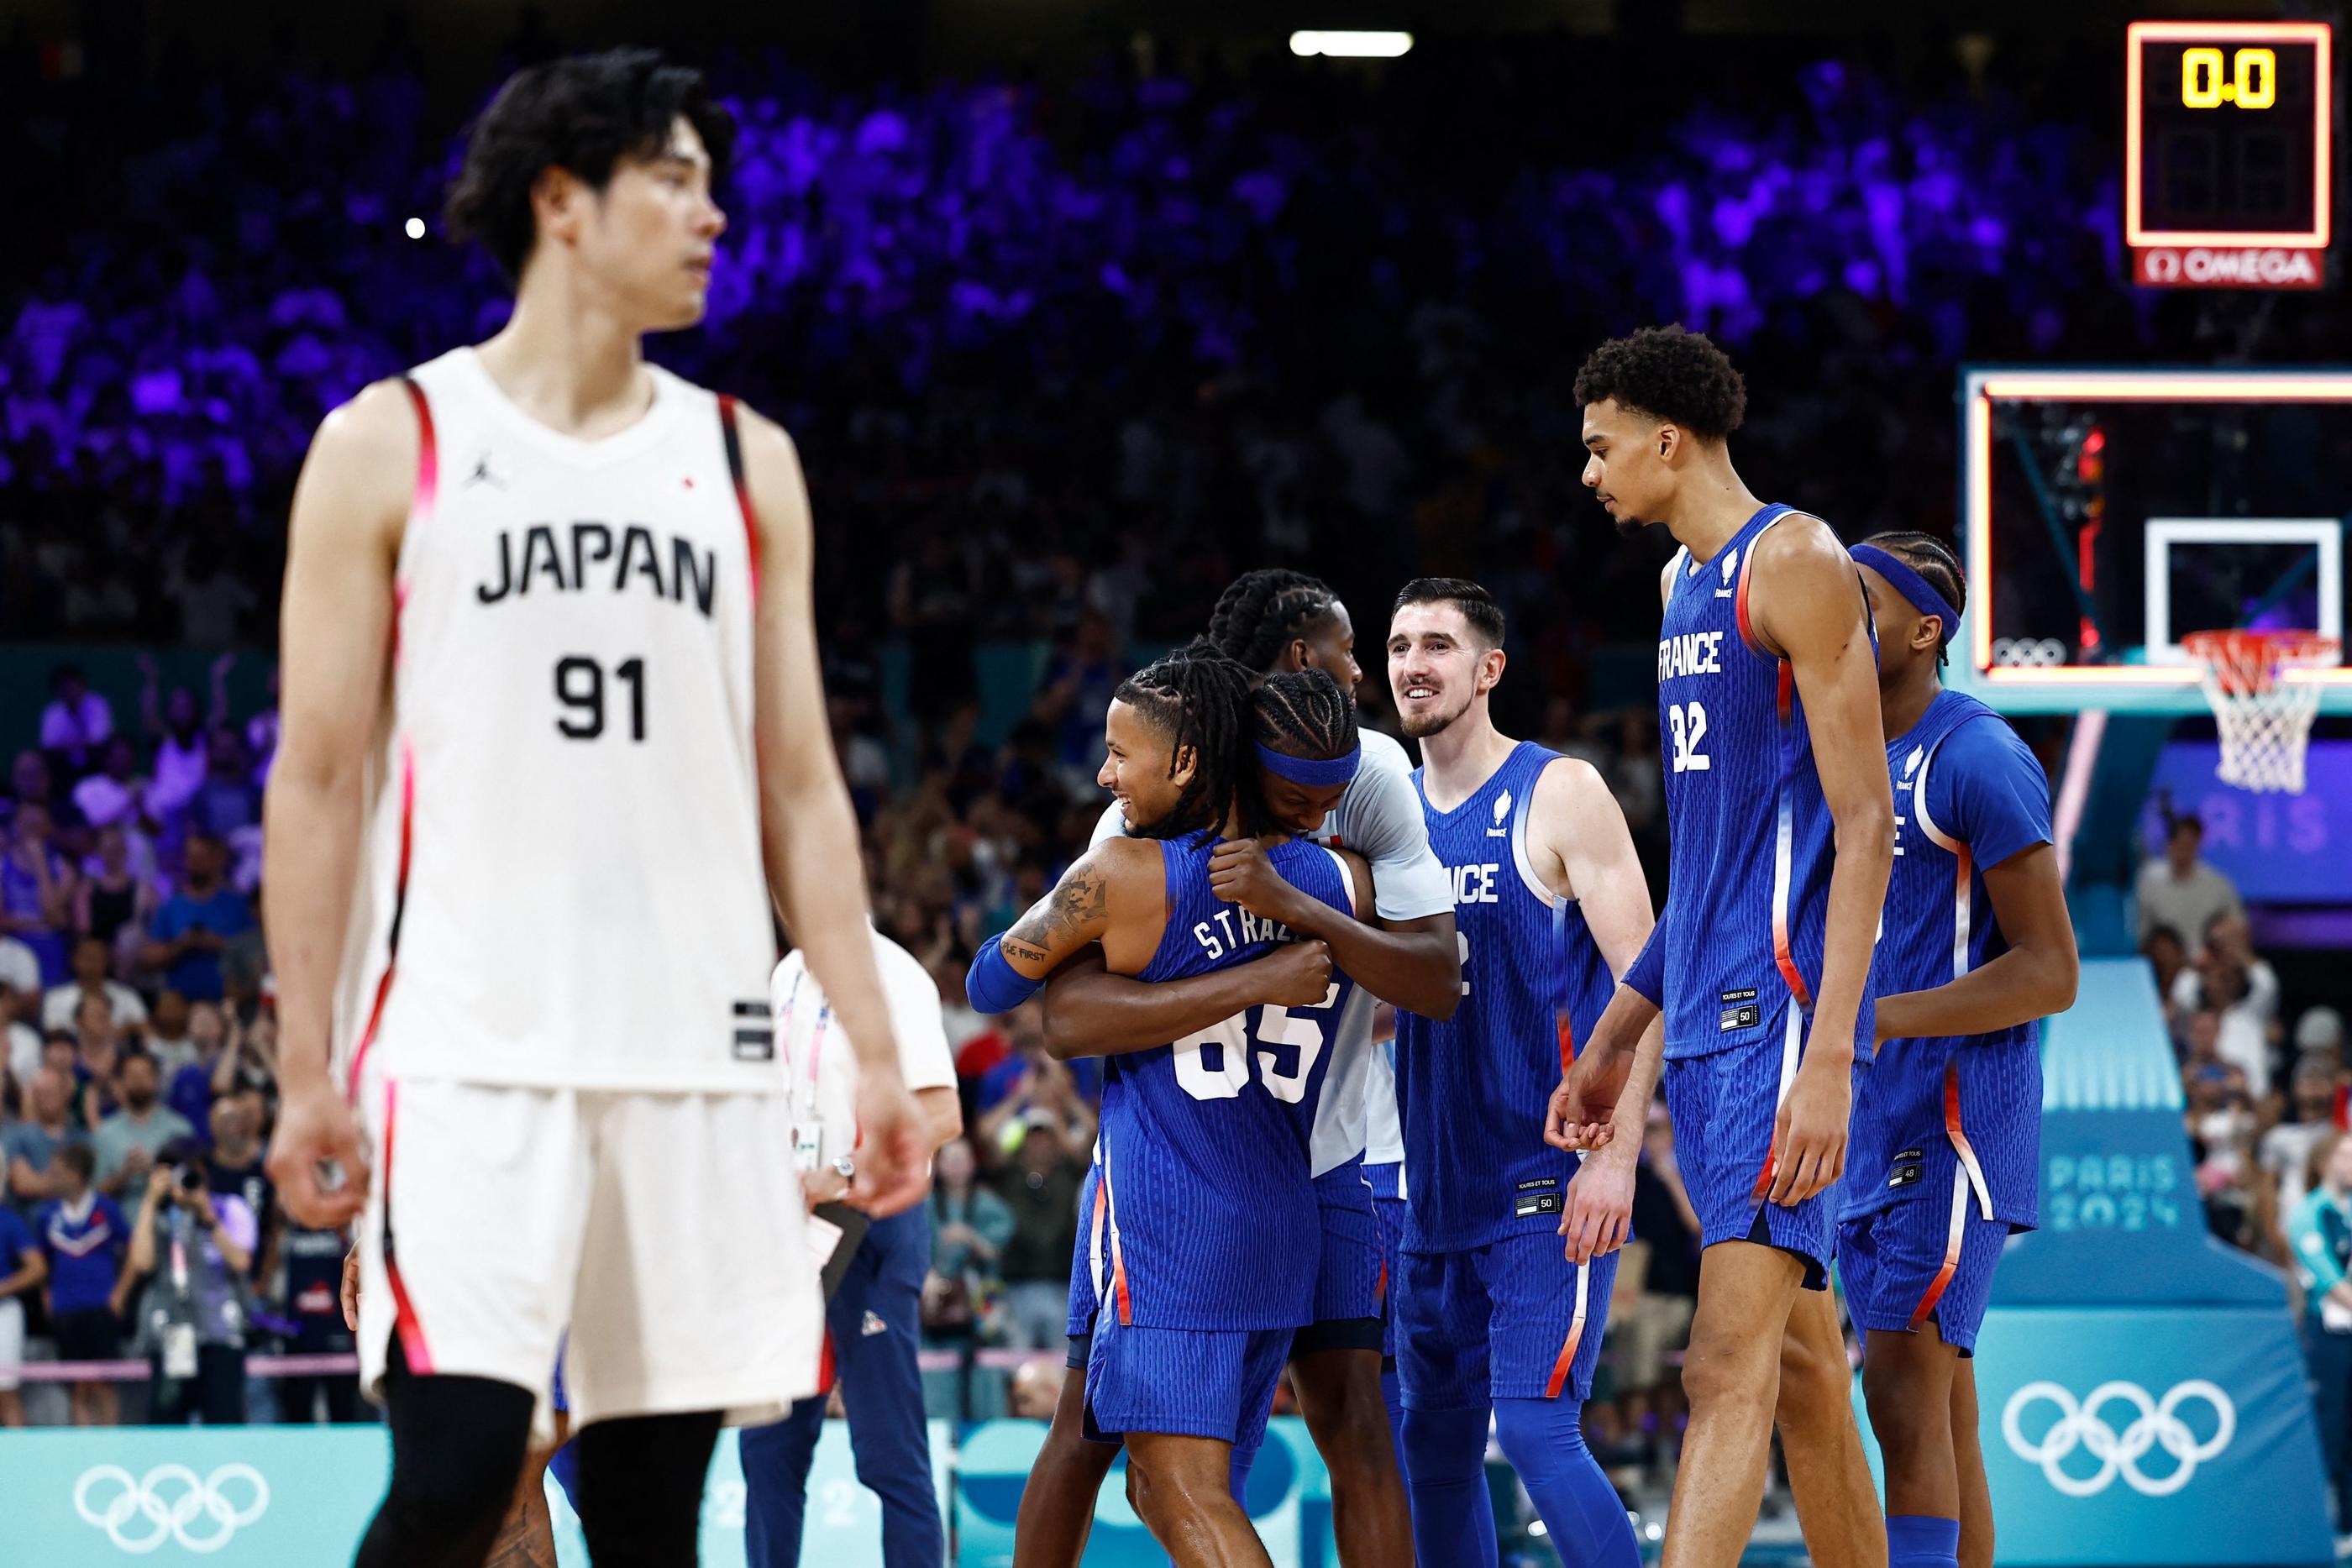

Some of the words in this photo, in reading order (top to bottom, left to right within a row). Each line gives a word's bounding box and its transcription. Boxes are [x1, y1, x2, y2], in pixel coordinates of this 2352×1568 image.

[2182, 47, 2276, 109] 0.0
[2184, 249, 2316, 284] OMEGA
[477, 523, 716, 619] JAPAN
[1714, 588, 1734, 599] FRANCE
[1658, 631, 1723, 684] FRANCE
[554, 656, 646, 742] 91
[1669, 700, 1711, 774] 32
[1486, 827, 1507, 837] FRANCE
[1443, 863, 1499, 905] NCE
[1019, 948, 1046, 962] FIRST
[1740, 1011, 1750, 1021] 50
[1905, 1169, 1914, 1177] 48
[1541, 1198, 1552, 1208] 50
